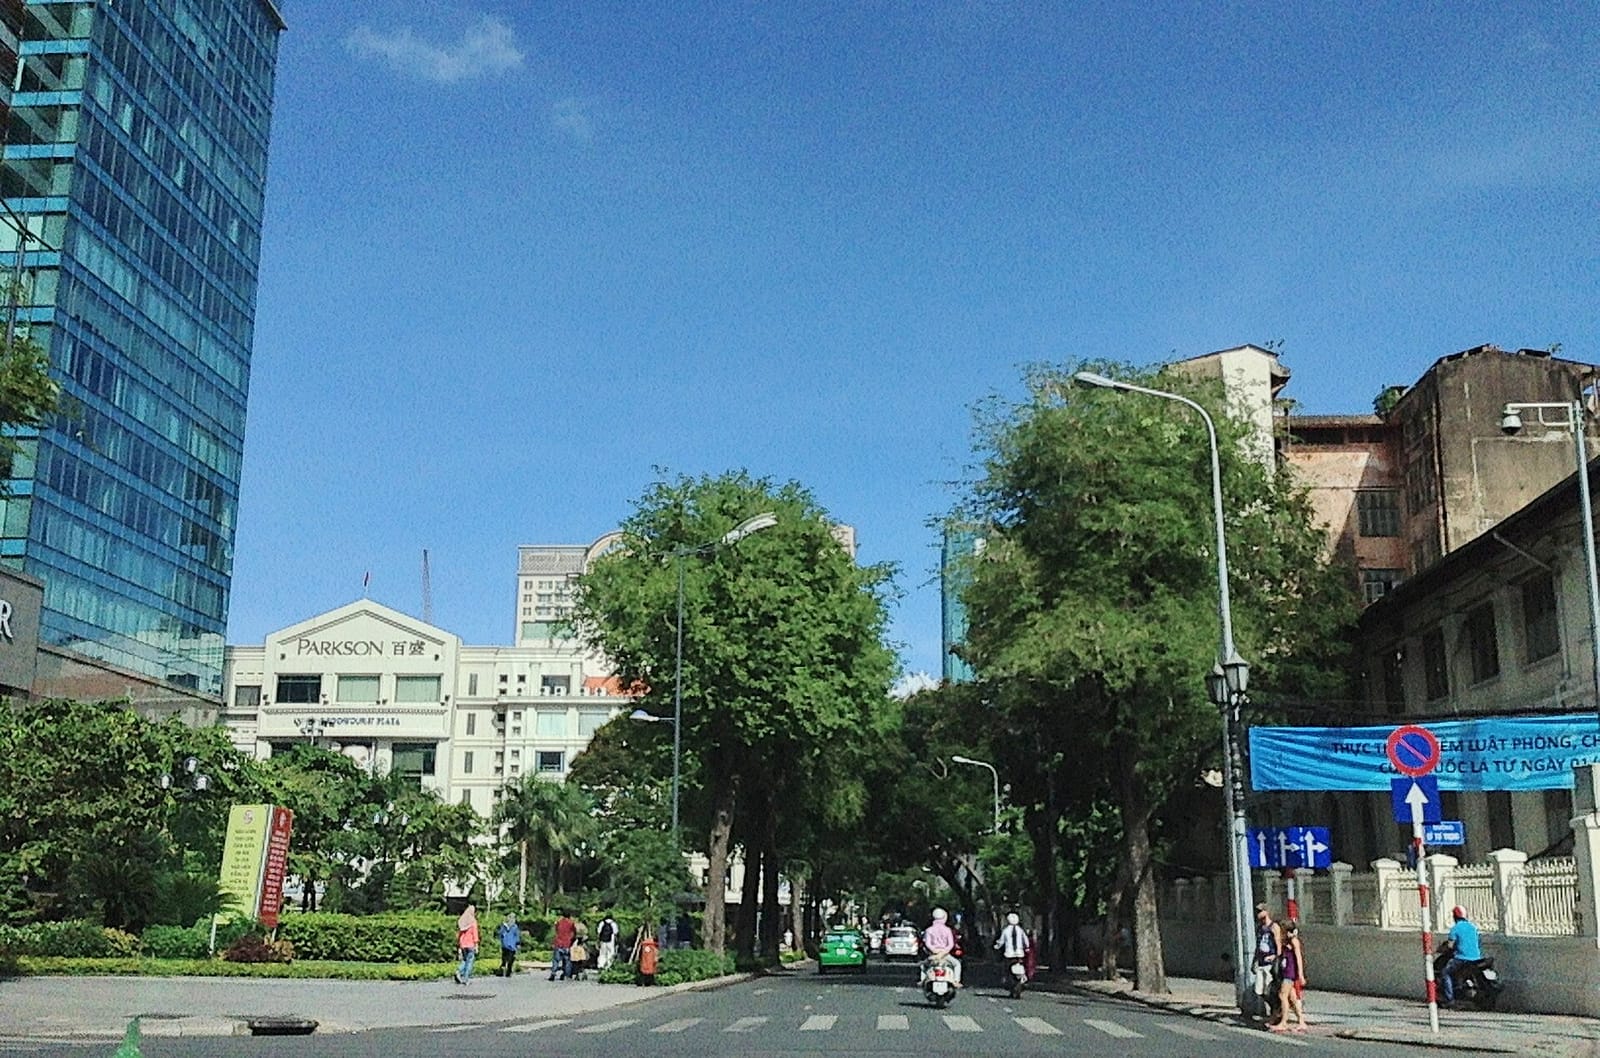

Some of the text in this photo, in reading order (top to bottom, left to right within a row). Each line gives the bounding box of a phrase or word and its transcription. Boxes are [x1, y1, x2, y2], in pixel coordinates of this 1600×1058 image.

[297, 637, 384, 656] PARKSON
[391, 639, 426, 656] 百盛
[1331, 742, 1371, 756] THỰC
[1468, 734, 1507, 754] LUẬT
[1493, 756, 1517, 773] TỪ
[1520, 755, 1565, 772] NGÀY
